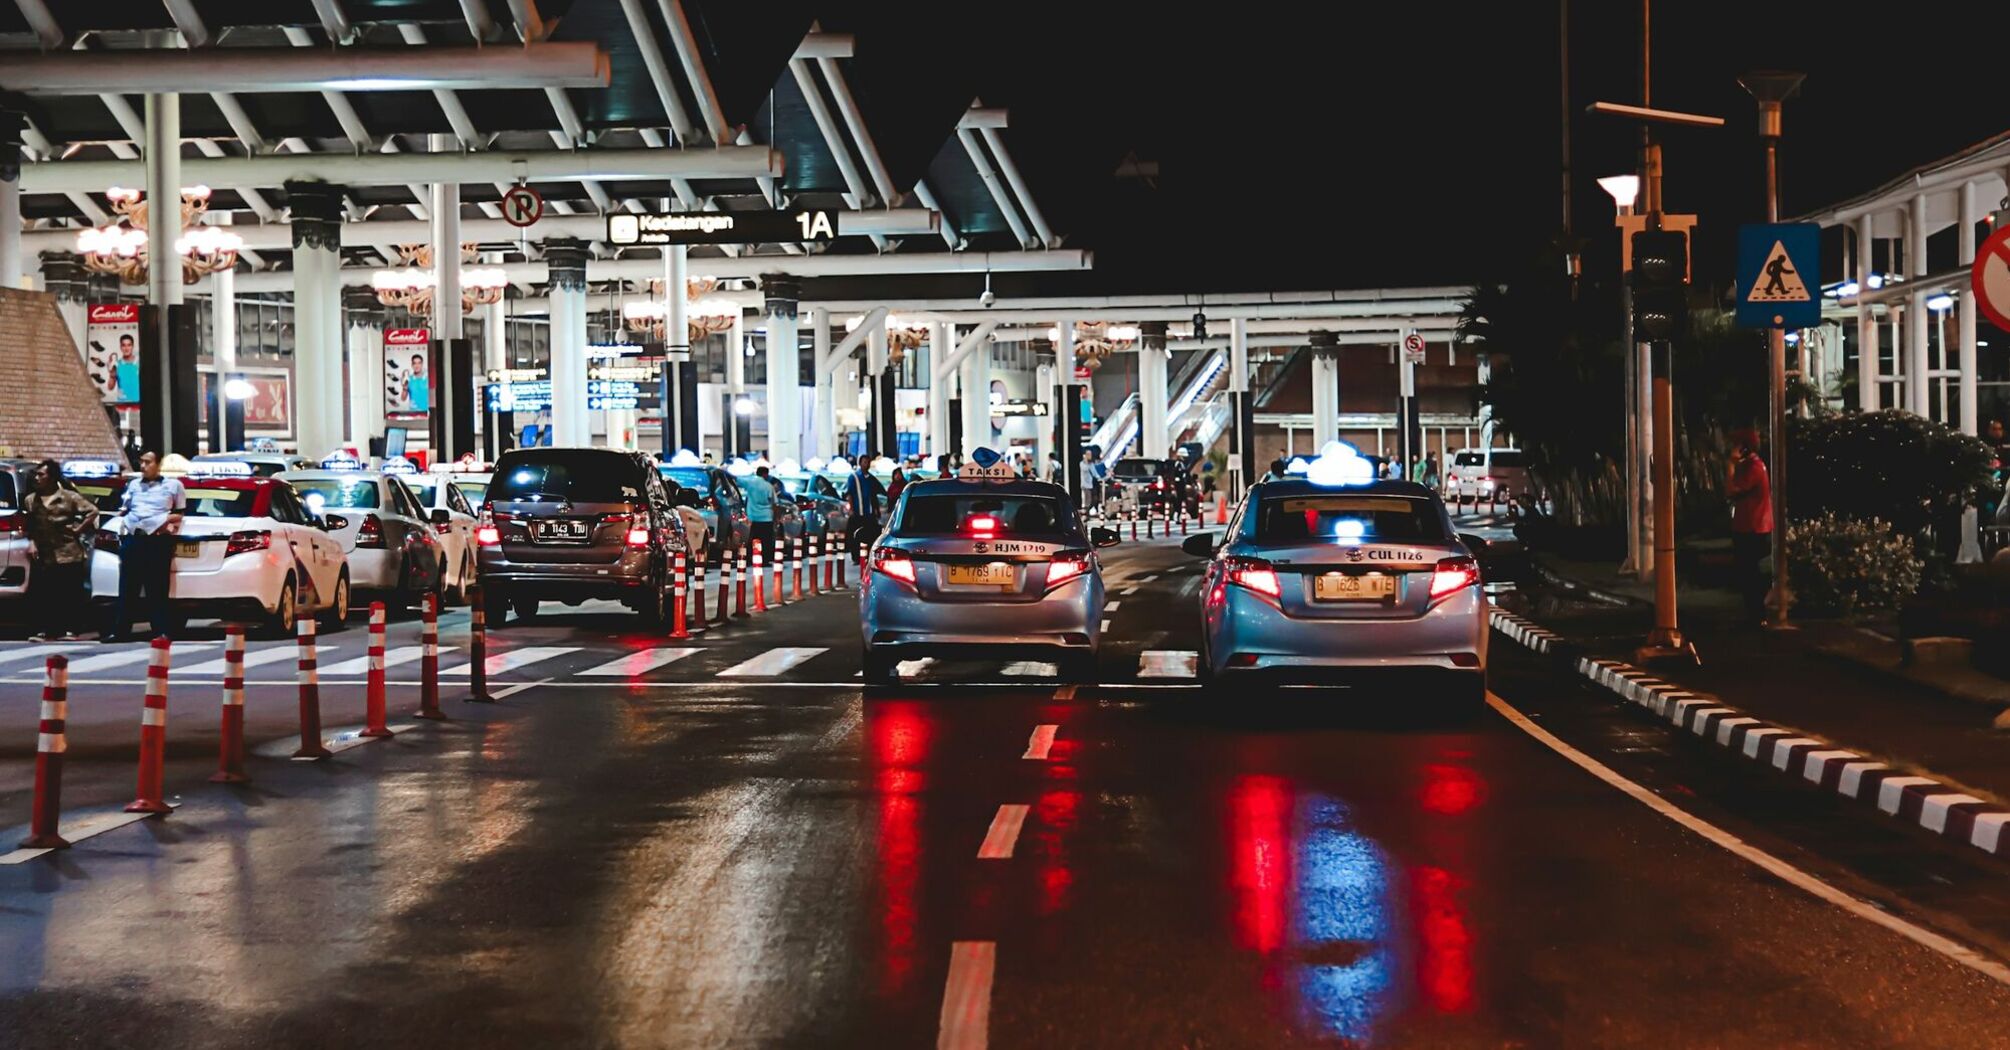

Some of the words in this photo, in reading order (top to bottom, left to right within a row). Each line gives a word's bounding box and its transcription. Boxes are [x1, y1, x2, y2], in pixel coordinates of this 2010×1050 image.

[515, 194, 533, 220] P
[796, 211, 834, 239] 1A
[968, 468, 1006, 476] TAKSI
[540, 523, 546, 533] B
[552, 523, 568, 533] 1143
[995, 544, 1020, 552] HJM
[1368, 550, 1393, 560] CUL
[1397, 551, 1423, 560] 1126
[950, 565, 957, 576] B
[1317, 576, 1324, 592] B
